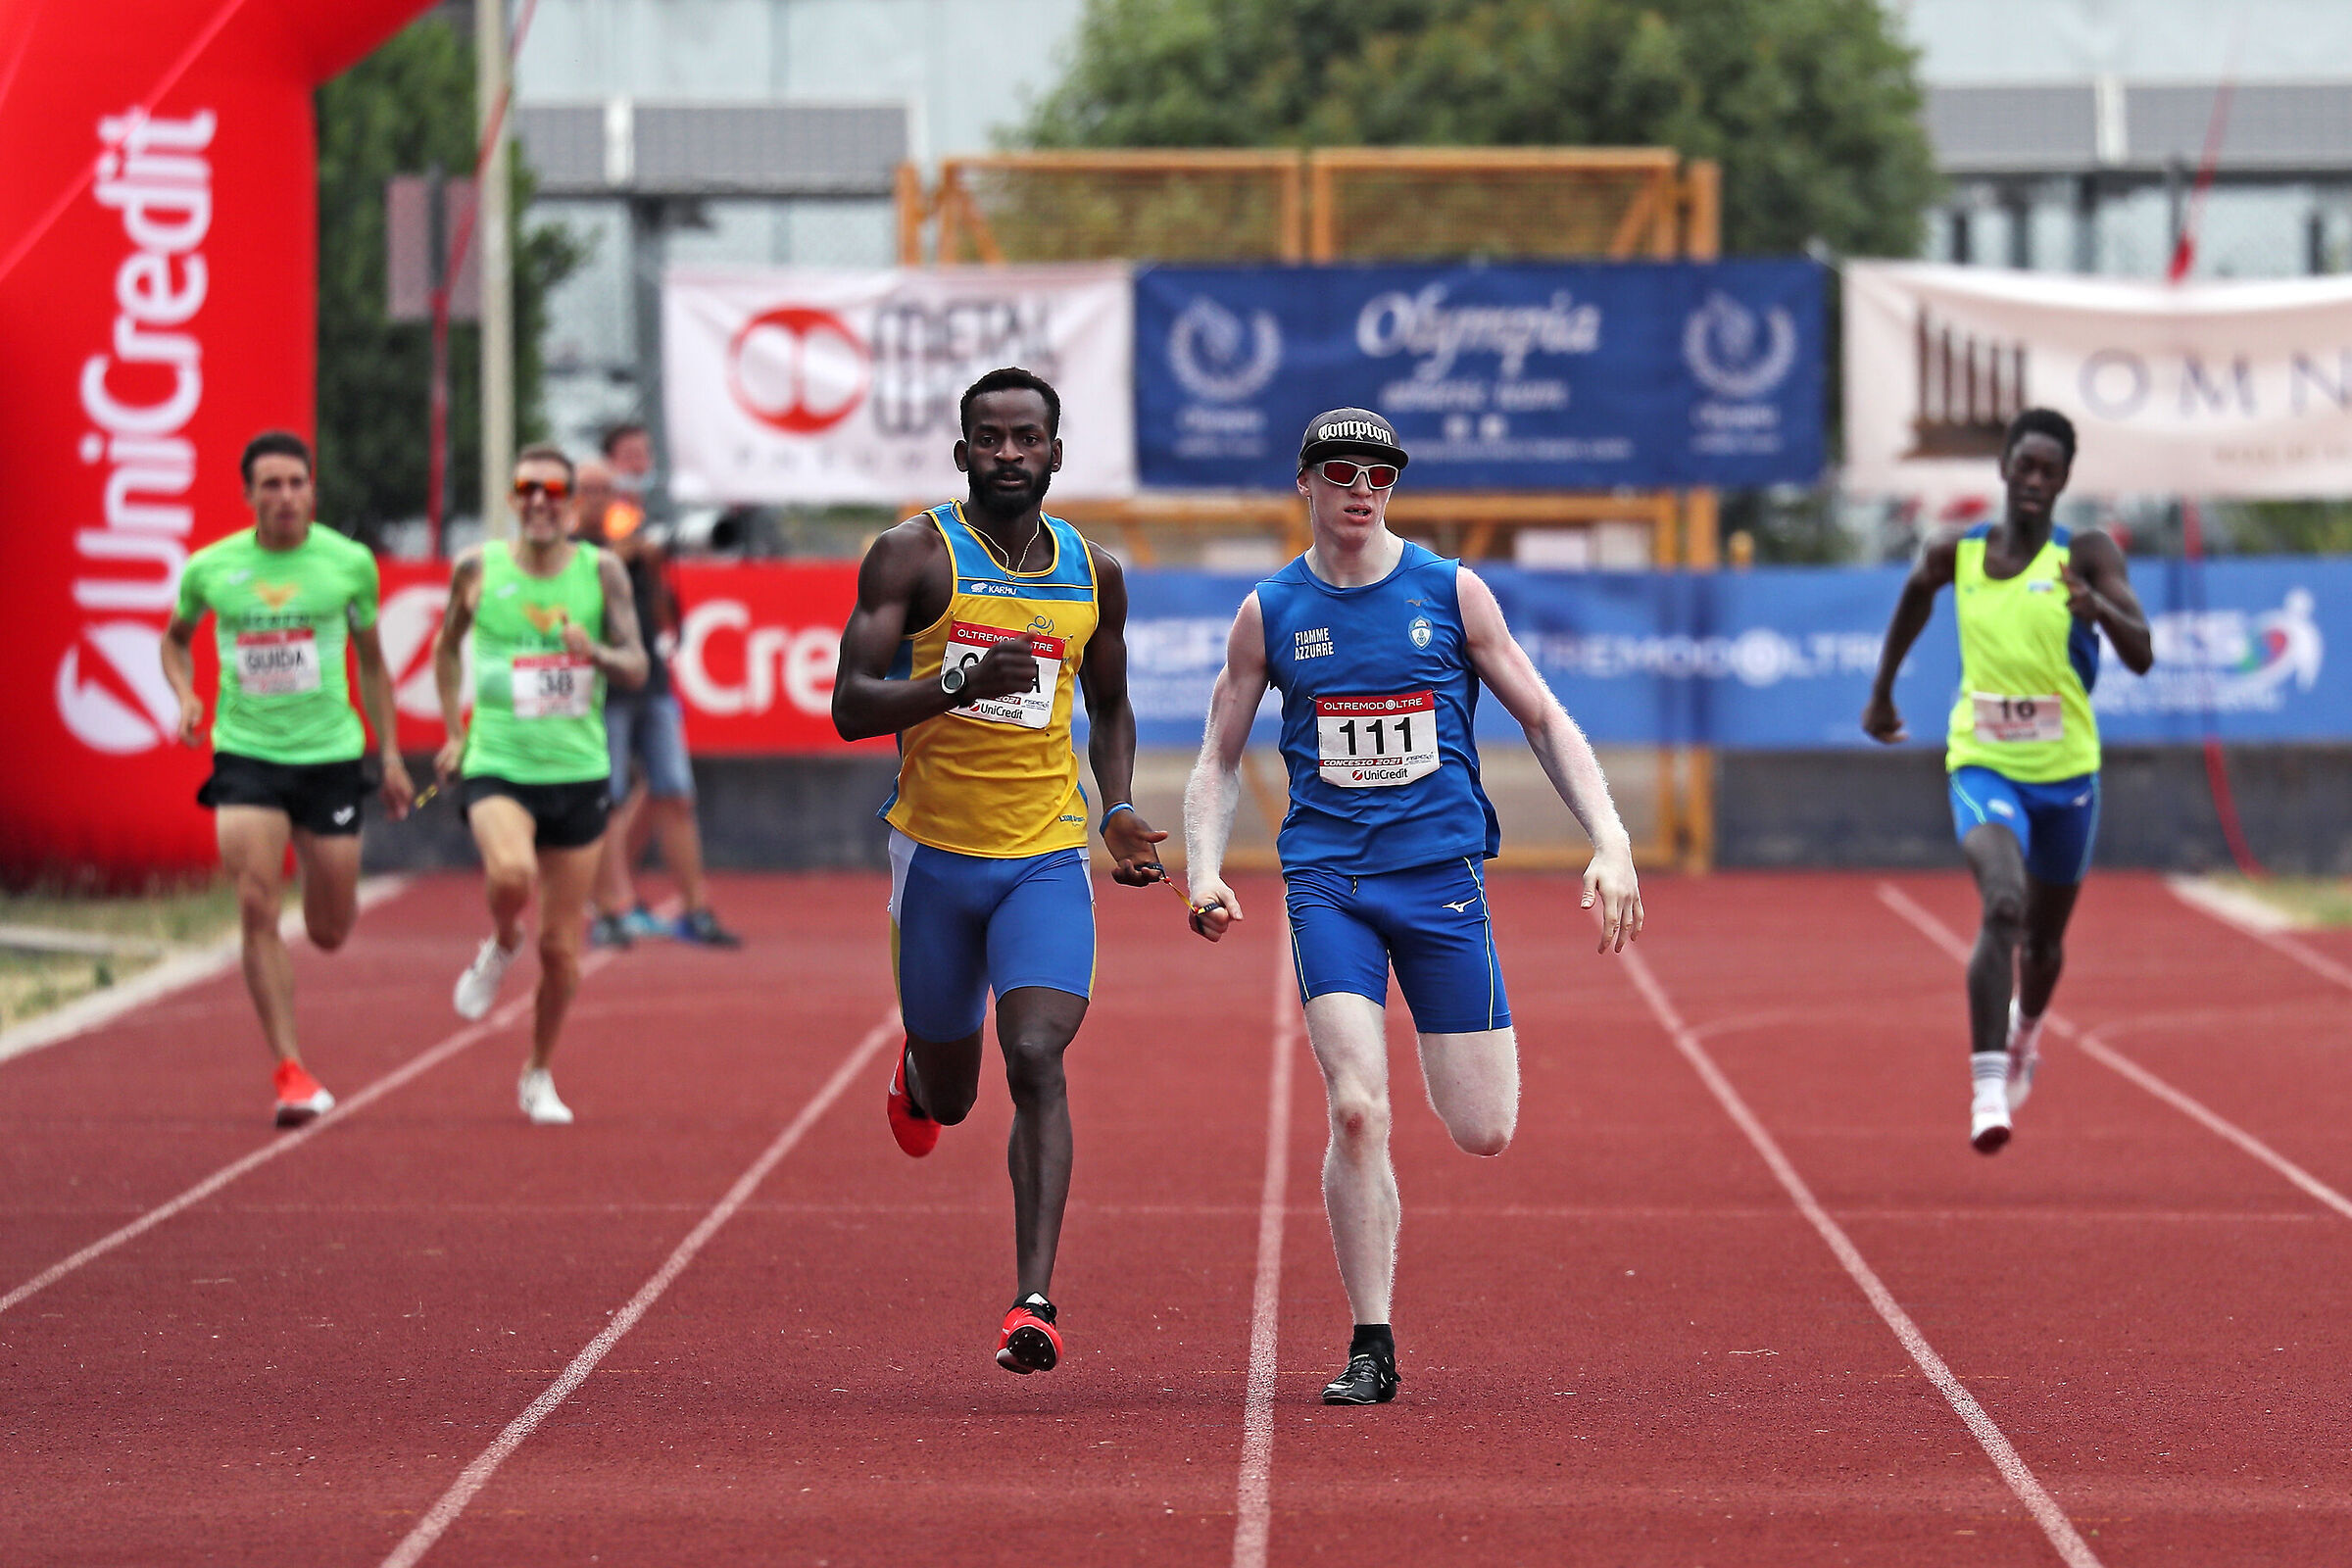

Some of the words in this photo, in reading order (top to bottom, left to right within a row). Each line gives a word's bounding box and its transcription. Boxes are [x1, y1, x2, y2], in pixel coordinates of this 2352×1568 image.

[1356, 283, 1601, 381] Olympia
[72, 105, 218, 612] UniCredit
[1318, 420, 1393, 445] Compton
[989, 585, 1017, 595] KARHU
[1295, 627, 1330, 646] FIAMME
[247, 649, 305, 670] GUIDA
[1295, 642, 1335, 661] AZZURRE
[981, 705, 1024, 720] UniCredit
[1324, 697, 1423, 710] OLTREMODOLTRE
[1339, 716, 1412, 756] 111
[1364, 768, 1408, 780] UniCredit
